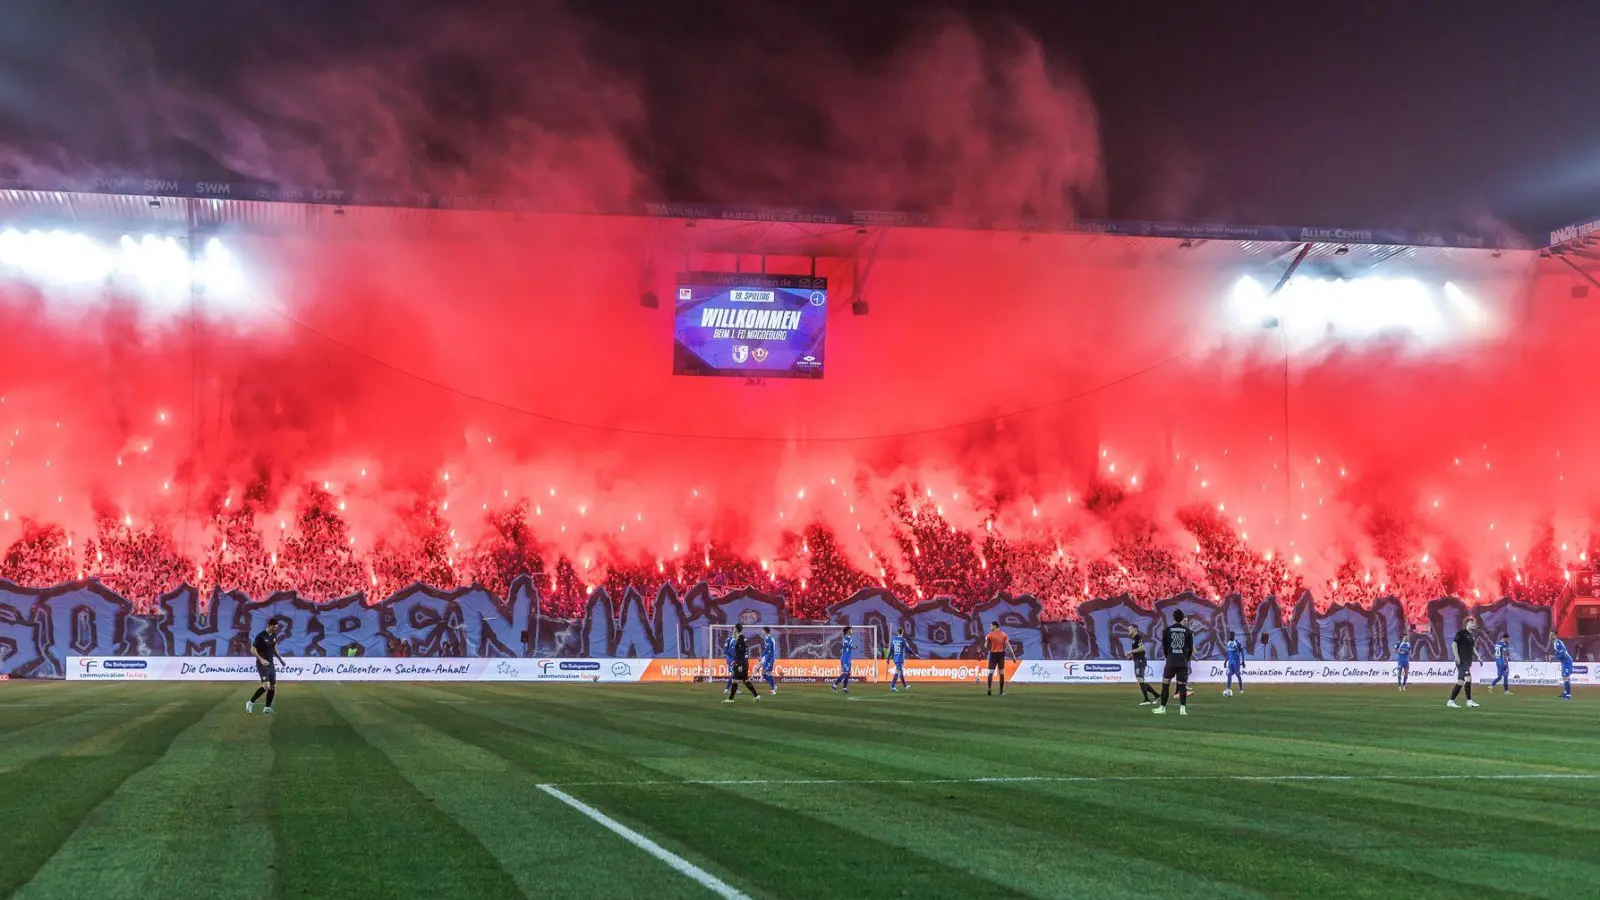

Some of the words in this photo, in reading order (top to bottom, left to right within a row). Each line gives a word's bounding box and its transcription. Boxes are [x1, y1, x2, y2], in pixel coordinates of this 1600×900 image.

[143, 179, 179, 192] SWM
[195, 181, 230, 194] SWM
[734, 291, 744, 300] 19.
[744, 291, 770, 301] SPIELTAG
[700, 308, 801, 330] WILLKOMMEN
[713, 329, 730, 339] BEIM
[737, 330, 746, 340] FC
[746, 330, 788, 341] MAGDEBURG
[180, 662, 197, 674] Die
[199, 663, 260, 674] Communicati
[313, 663, 334, 674] Dein
[336, 663, 381, 675] Callcenter
[383, 664, 392, 674] in
[394, 663, 471, 675] Sachsen-Anhalt!
[661, 664, 678, 676] Wir
[680, 664, 717, 676] suchen
[1210, 666, 1224, 677] Die
[1284, 667, 1315, 678] Factory
[1322, 666, 1340, 677] Dein
[1342, 667, 1379, 677] Callcenter
[1382, 668, 1390, 677] in
[1392, 667, 1457, 677] Ssen-Anhalt!
[126, 671, 148, 679] factory
[580, 672, 601, 680] factory
[1104, 674, 1122, 682] factory
